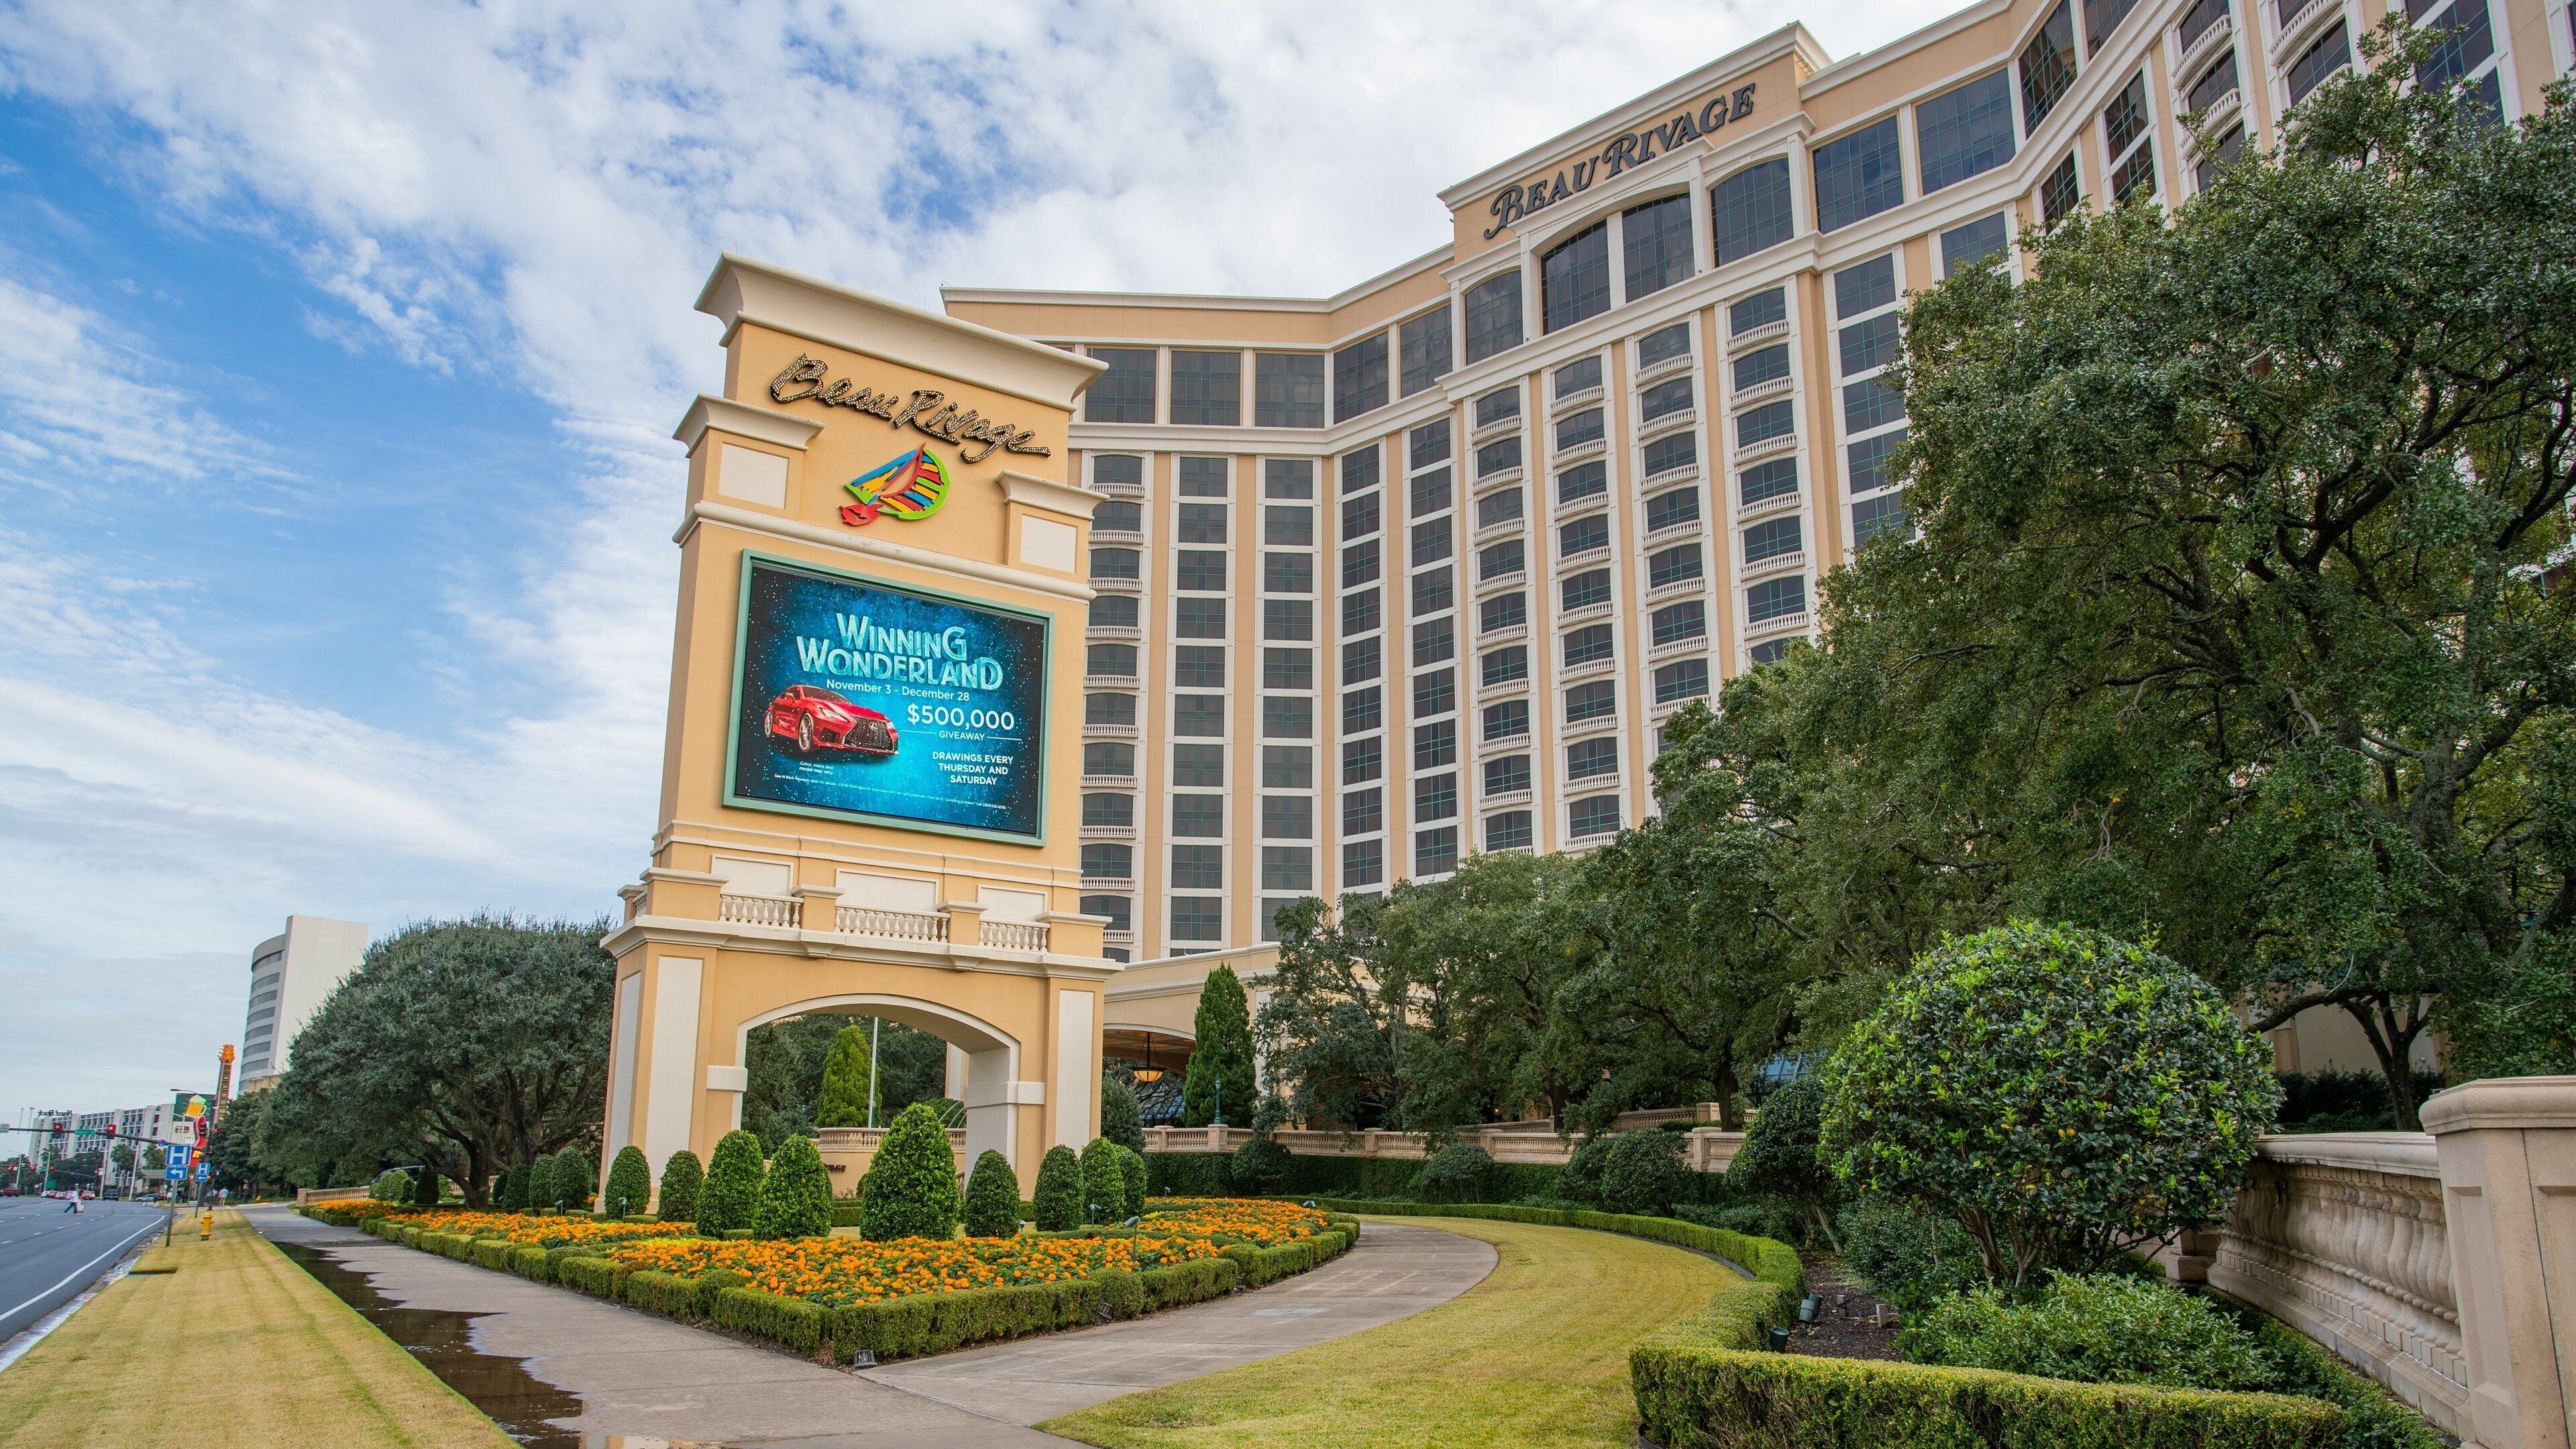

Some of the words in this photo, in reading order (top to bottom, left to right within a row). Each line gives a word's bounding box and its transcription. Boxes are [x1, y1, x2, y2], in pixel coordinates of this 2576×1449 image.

[1483, 154, 1601, 240] BEAU
[1601, 82, 1756, 180] RIVAGE
[770, 353, 900, 421] Beau
[893, 389, 1051, 464] Rivage
[836, 612, 967, 661] WINNING
[796, 635, 1004, 691] WONDERLAND
[826, 678, 882, 694] November
[885, 684, 892, 694] 3
[902, 686, 955, 700] December
[957, 691, 970, 702] 28
[907, 702, 1015, 731] $500,000
[939, 730, 985, 741] GIVEAWAY
[932, 751, 983, 763] DRAWINGS
[984, 754, 1014, 765] EVERY
[938, 763, 987, 773] THURSDAY
[988, 765, 1009, 775] AND
[950, 774, 998, 786] SATURDAY
[168, 1146, 189, 1165] H
[198, 1164, 208, 1174] H
